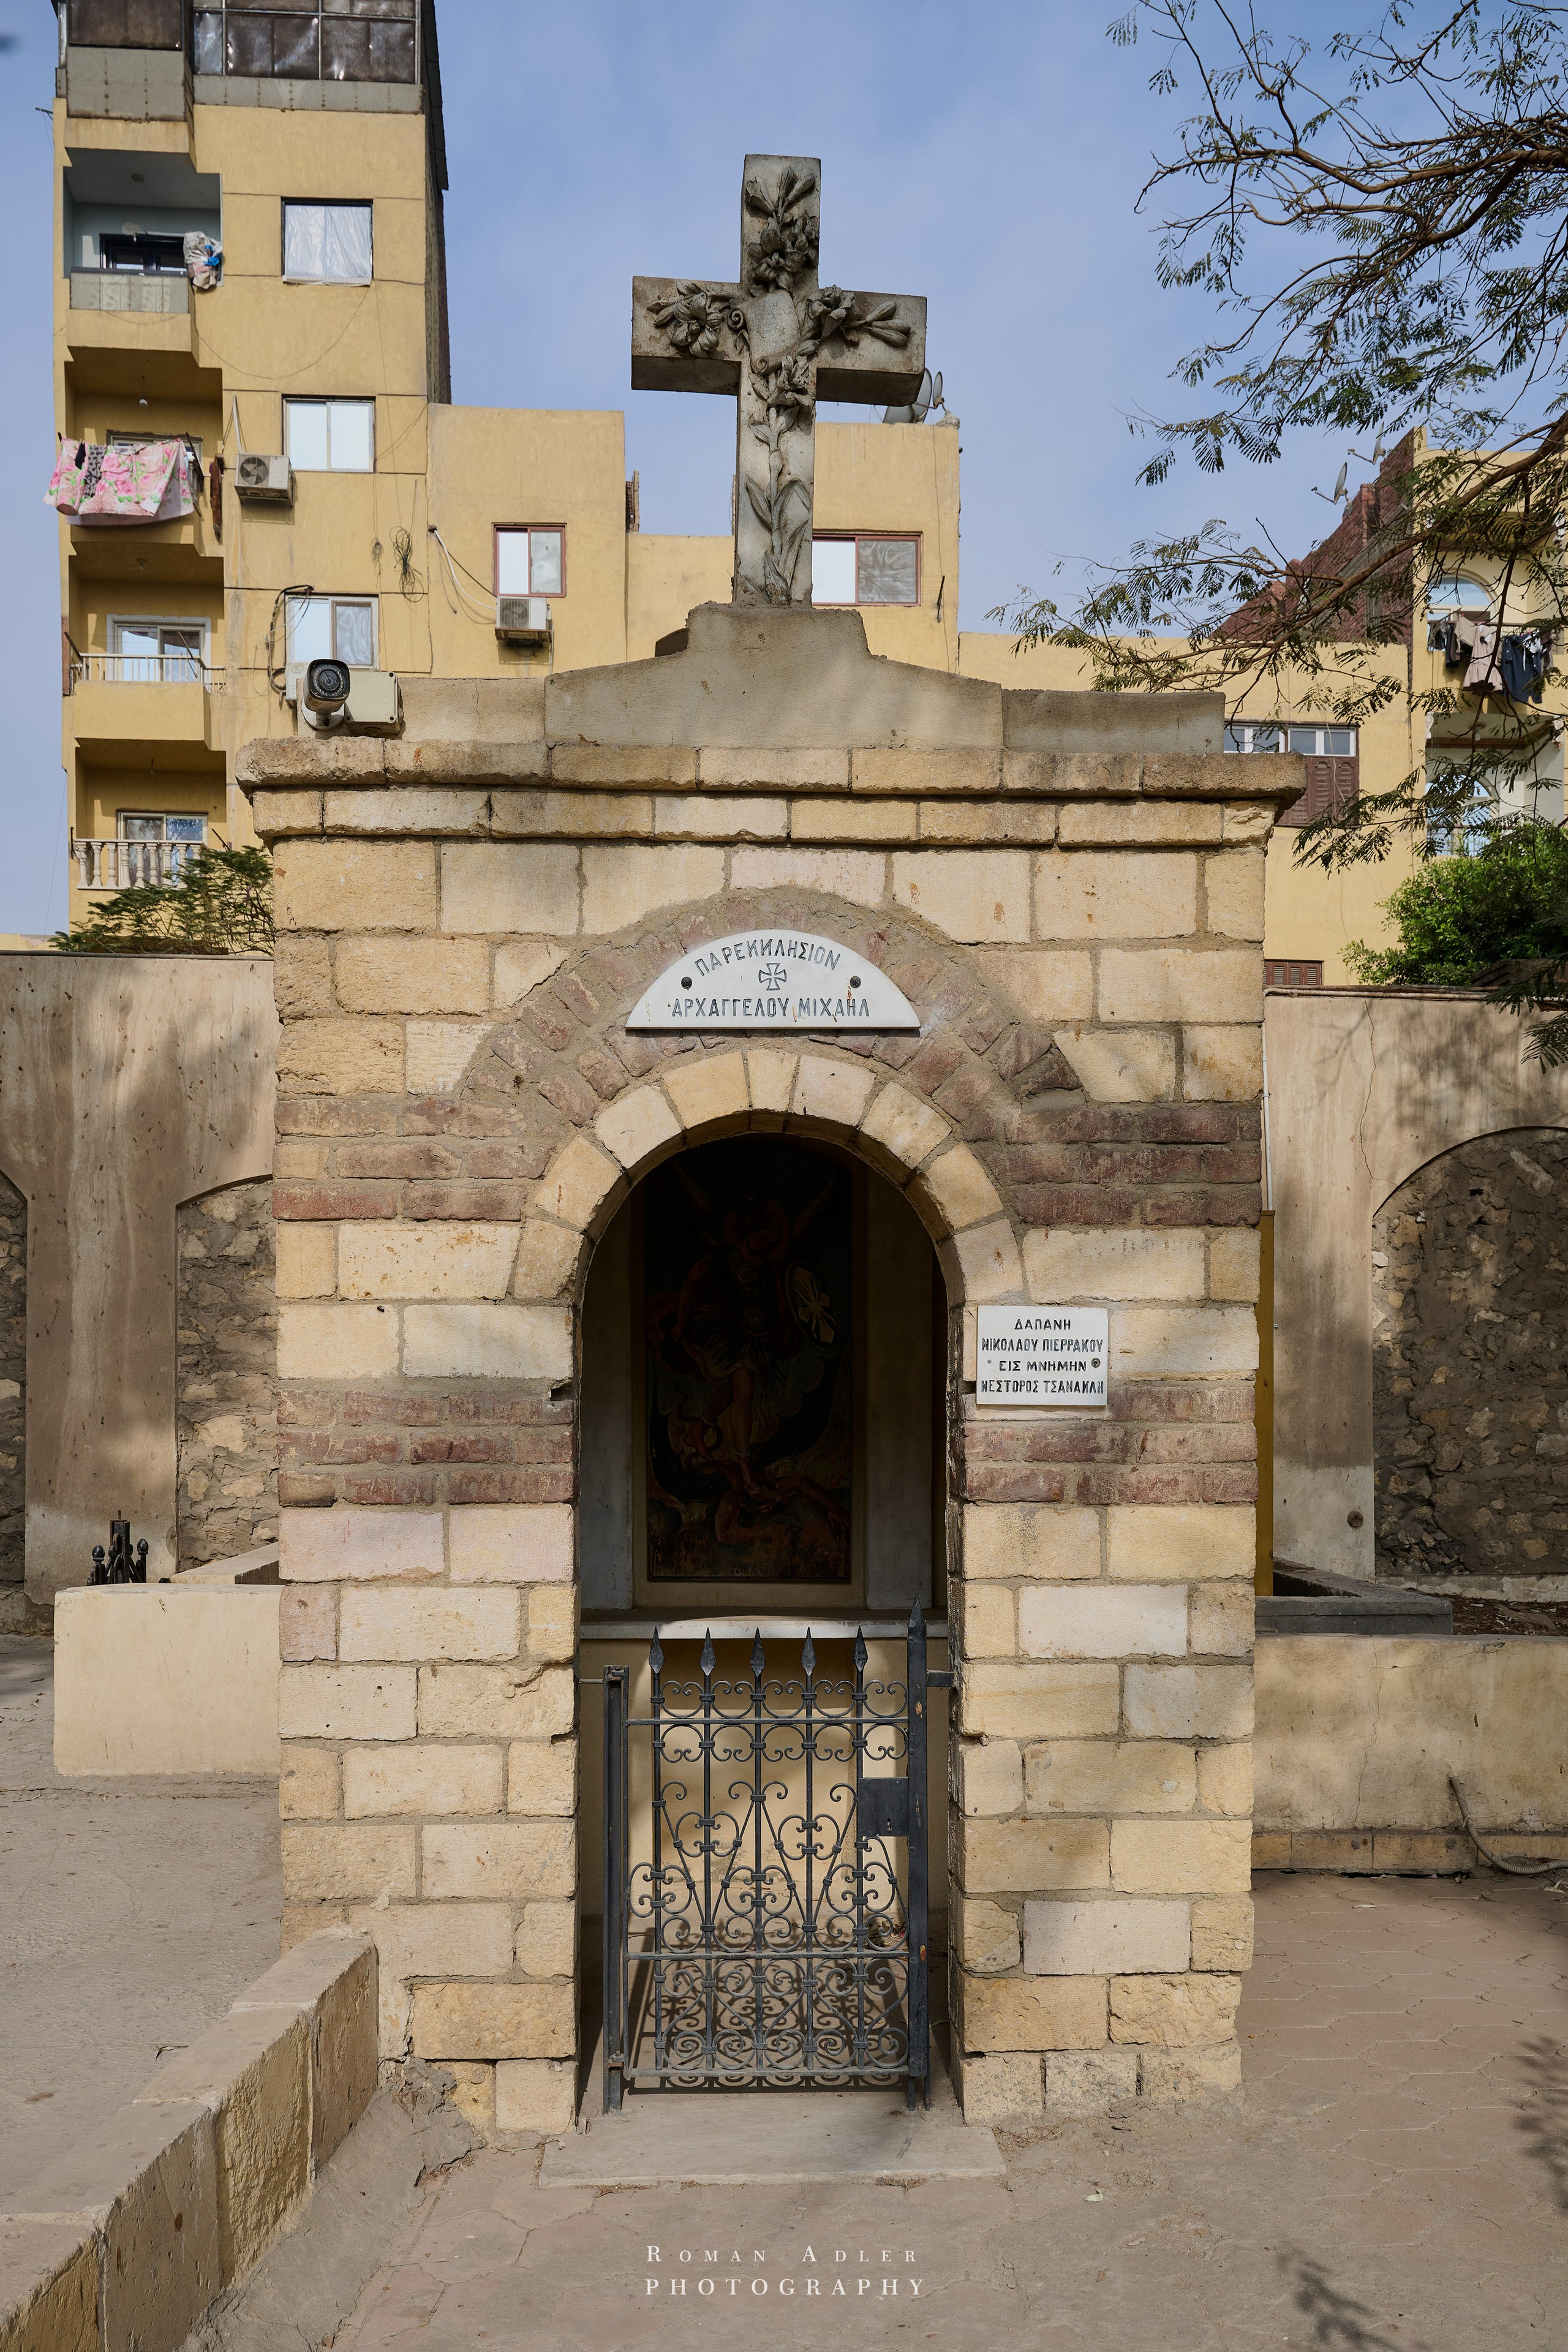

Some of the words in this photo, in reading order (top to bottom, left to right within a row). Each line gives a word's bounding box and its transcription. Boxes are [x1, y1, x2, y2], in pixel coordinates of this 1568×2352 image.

[694, 938, 841, 976] ΠΑΡΕΚΚΛΗΣΙΟΝ
[671, 997, 790, 1018] ΑΡΧΑΓΓΕΛΟΥ
[797, 998, 870, 1017] ΜΙΧΑΗΛ
[1014, 1319, 1071, 1330] ΔΑΠΑΝΗ
[981, 1338, 1038, 1352] ΝΙΚΟΛΑΟΥ
[1042, 1338, 1103, 1352] ΠΙΕΡΡΑΚΟΥ
[999, 1360, 1021, 1371] ΕΙΣ
[1026, 1361, 1087, 1371] ΜΝΗΜΗΝ
[981, 1379, 1039, 1393] ΝΕΣΤΟΡΟΣ
[1043, 1380, 1104, 1394] ΤΣΑΝΑΚΛΗ
